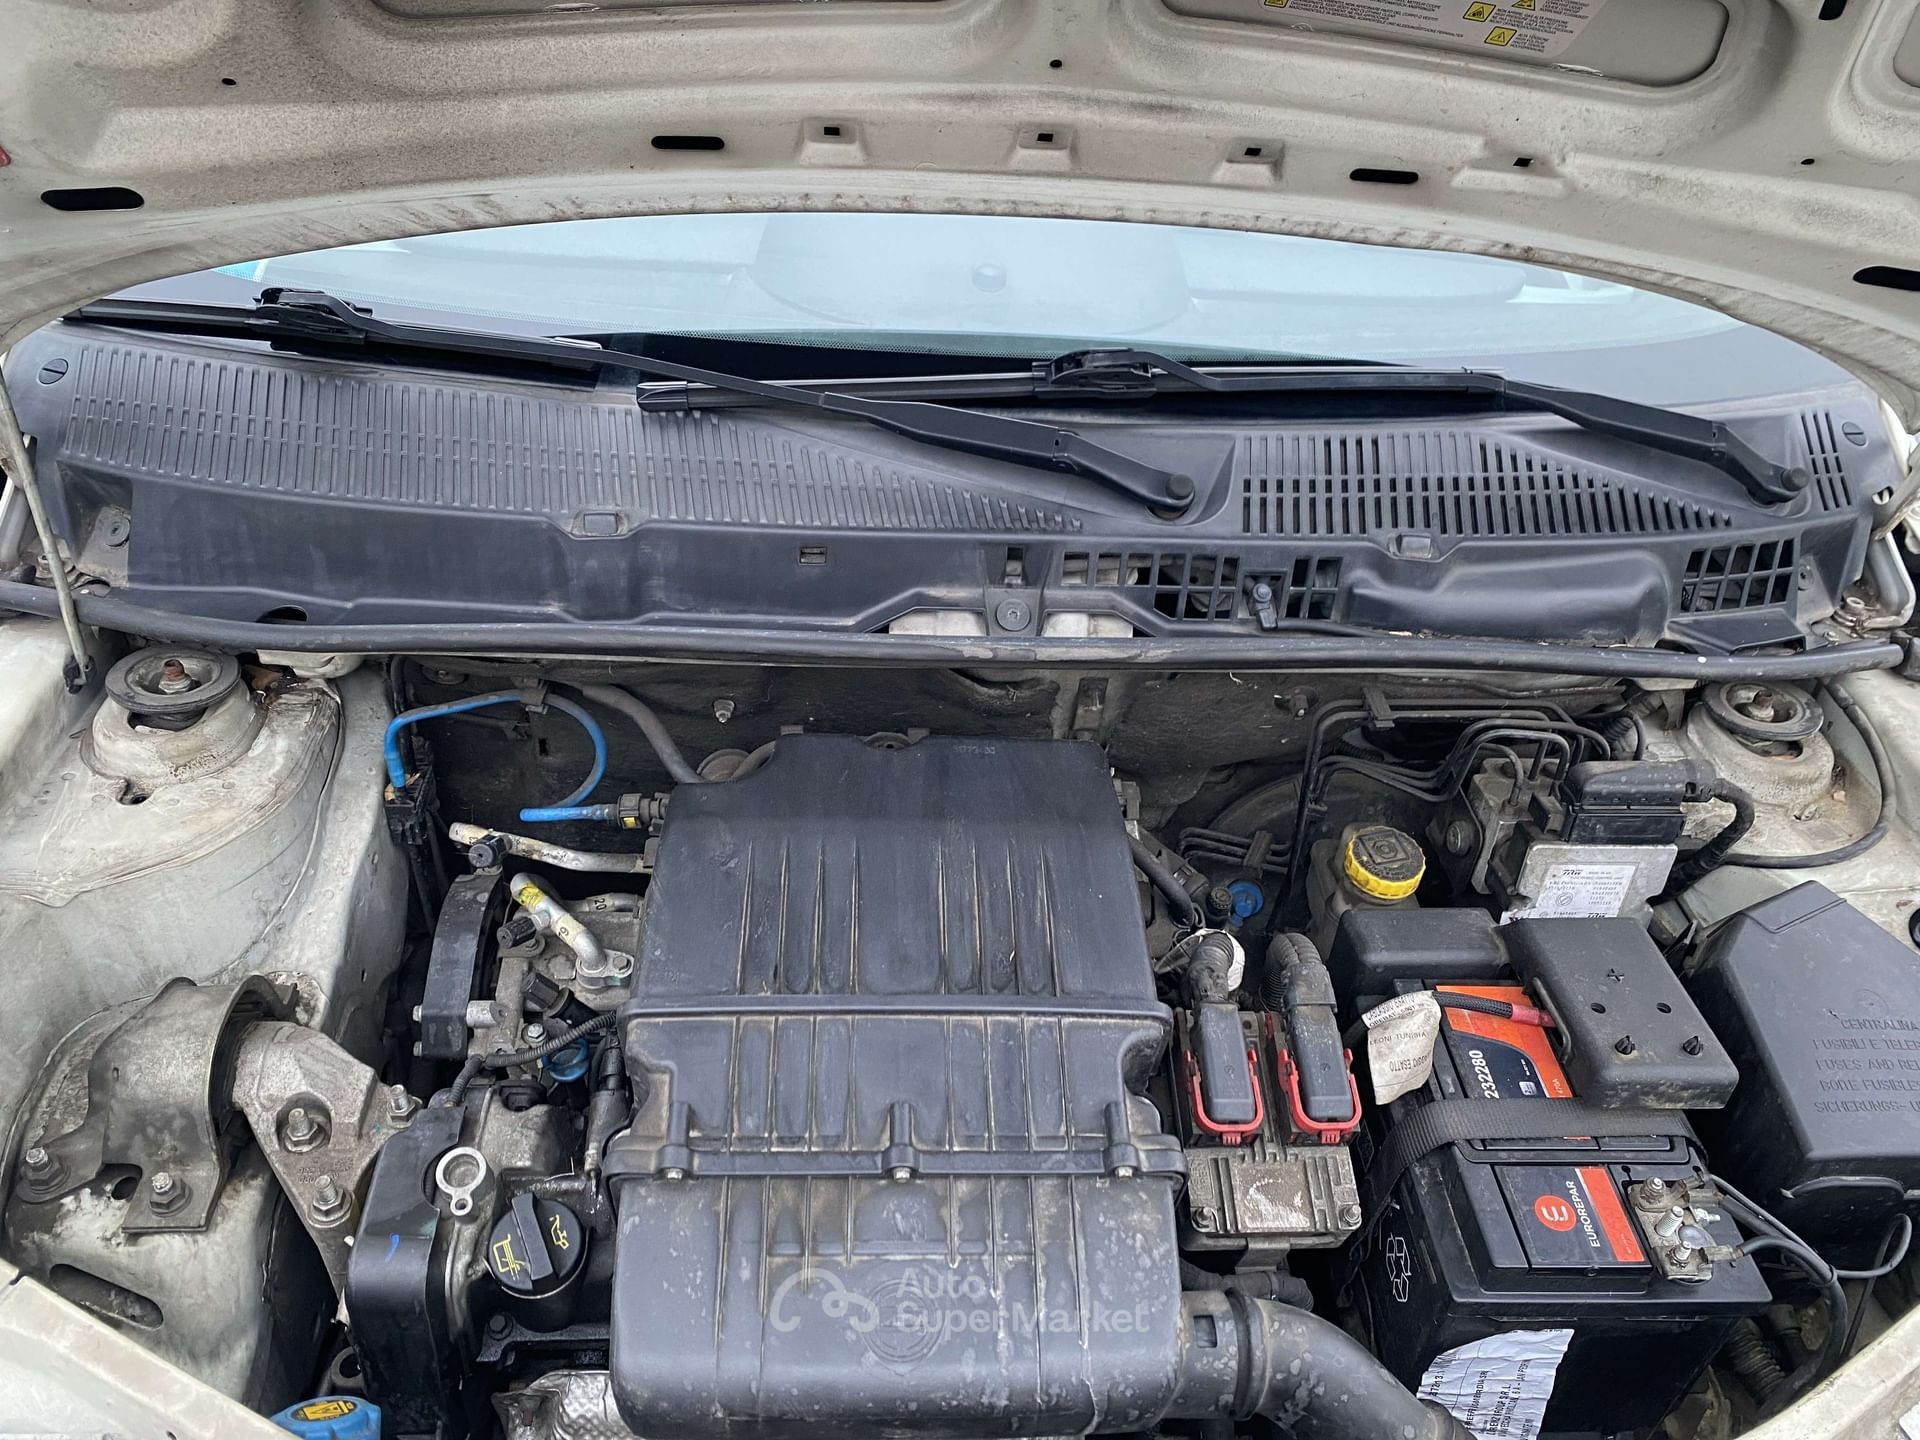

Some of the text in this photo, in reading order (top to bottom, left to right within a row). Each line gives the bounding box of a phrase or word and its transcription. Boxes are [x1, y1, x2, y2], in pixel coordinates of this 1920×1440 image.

[594, 897, 607, 911] 20
[1840, 1018, 1919, 1031] CENTRALINA
[1812, 1039, 1866, 1050] FUSIBILI
[1870, 1039, 1882, 1050] E
[1390, 1059, 1412, 1073] ESATTO
[1815, 1059, 1862, 1071] FUSES
[1868, 1059, 1894, 1070] AND
[1468, 1050, 1500, 1099] 232280
[1565, 1181, 1601, 1248] EUROREPAR
